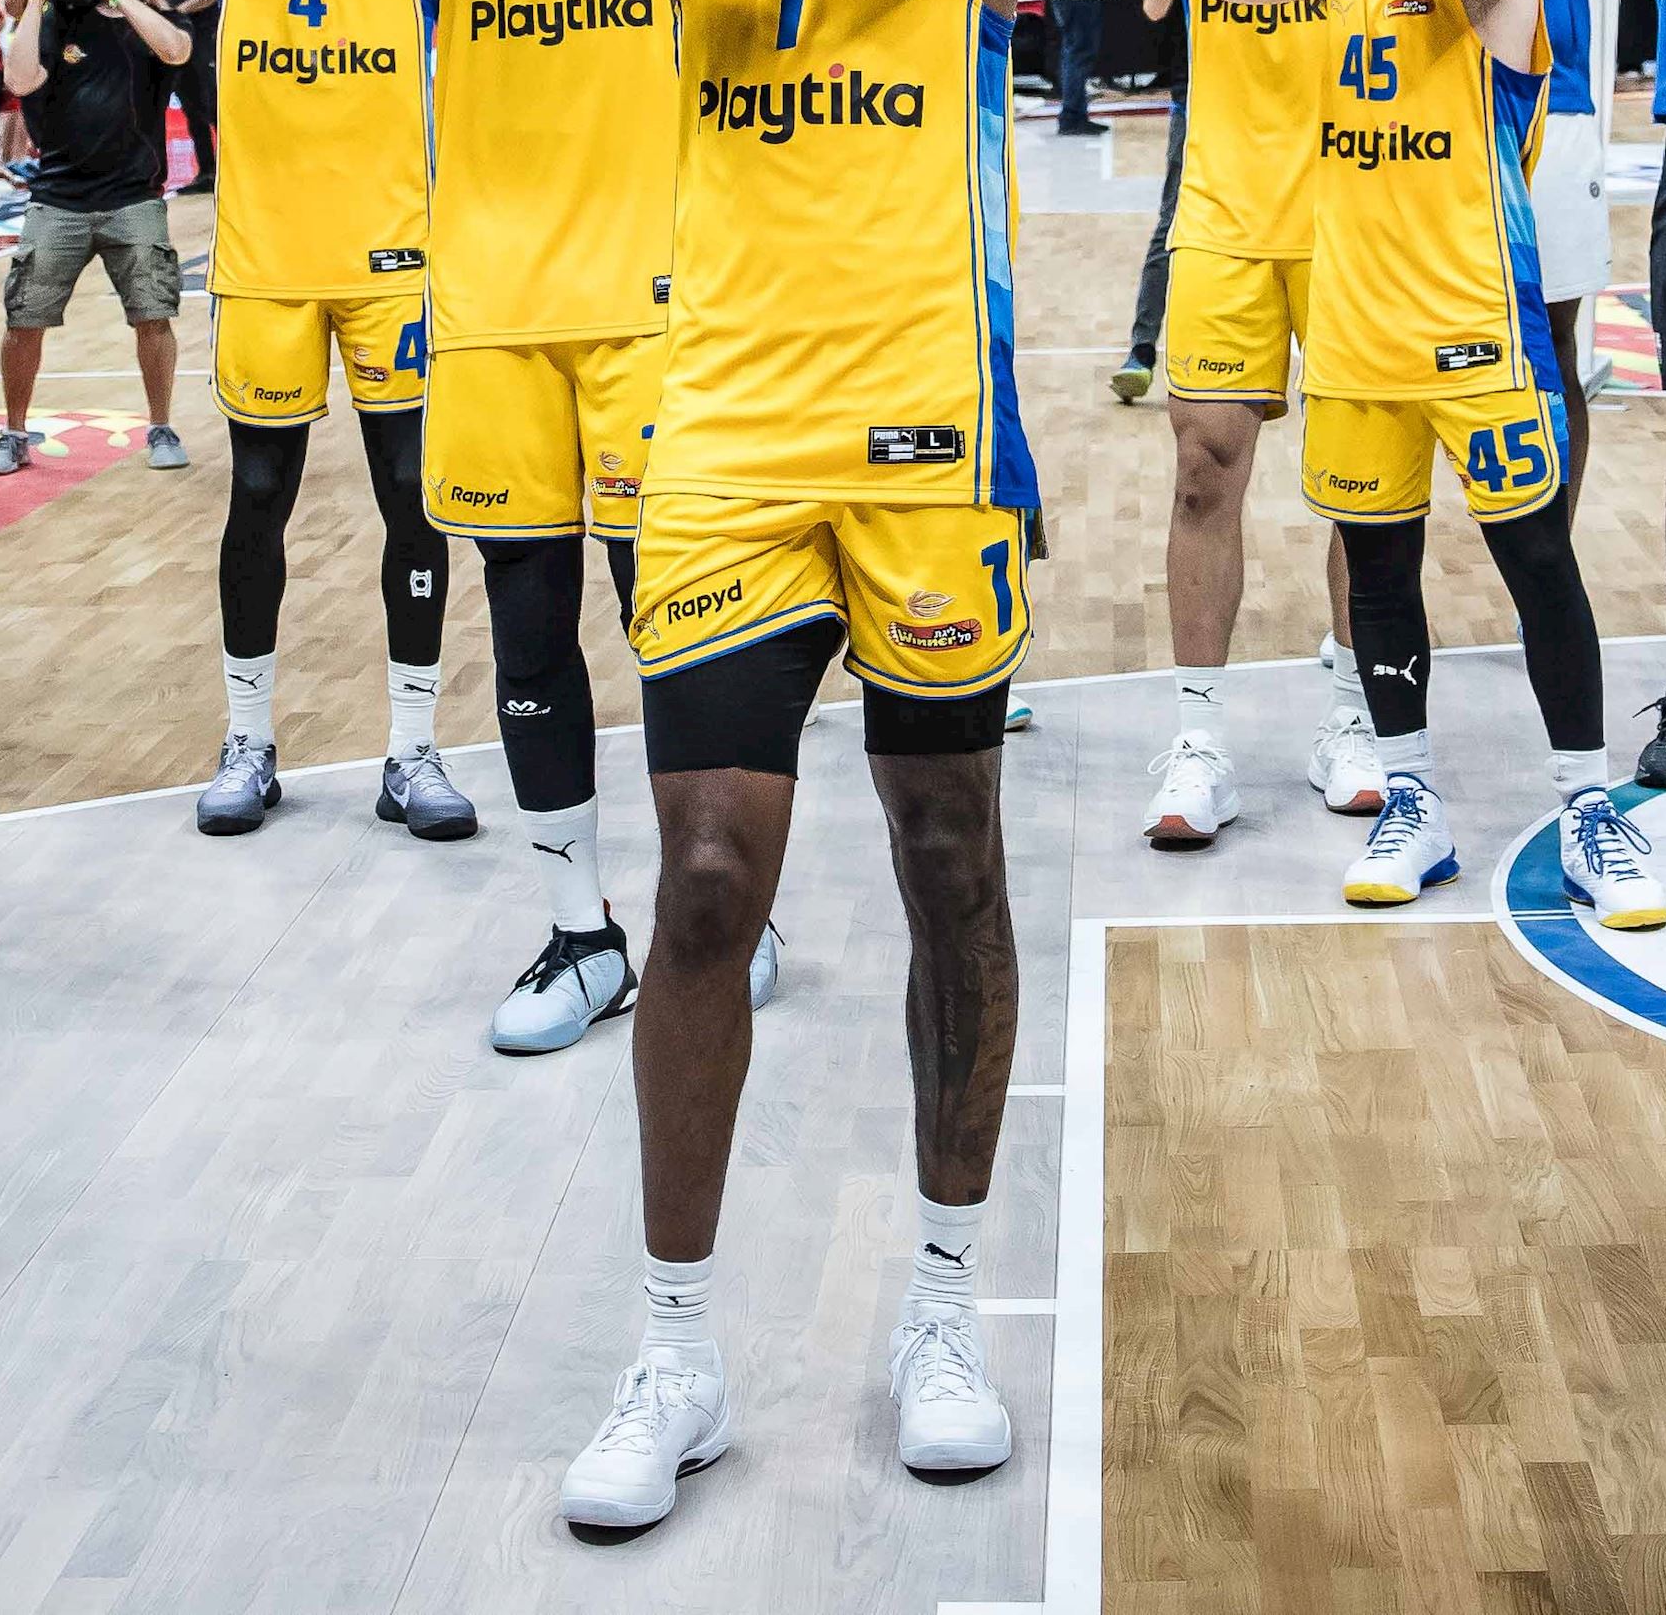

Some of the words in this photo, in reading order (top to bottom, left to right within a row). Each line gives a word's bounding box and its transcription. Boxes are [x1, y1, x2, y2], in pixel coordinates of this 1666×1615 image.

[237, 38, 396, 84] Playtika
[1339, 35, 1400, 101] 45
[700, 63, 924, 144] Playtika
[1198, 359, 1245, 375] Rapyd
[254, 387, 302, 403] Rapyd
[930, 432, 940, 446] L
[1468, 419, 1548, 492] 45
[1329, 475, 1379, 494] Rapyd
[451, 486, 509, 508] Rapyd
[981, 539, 1013, 636] 1
[667, 579, 742, 625] Rapyd
[897, 628, 956, 647] Winner
[957, 632, 972, 643] סל
[934, 627, 956, 639] ליגת
